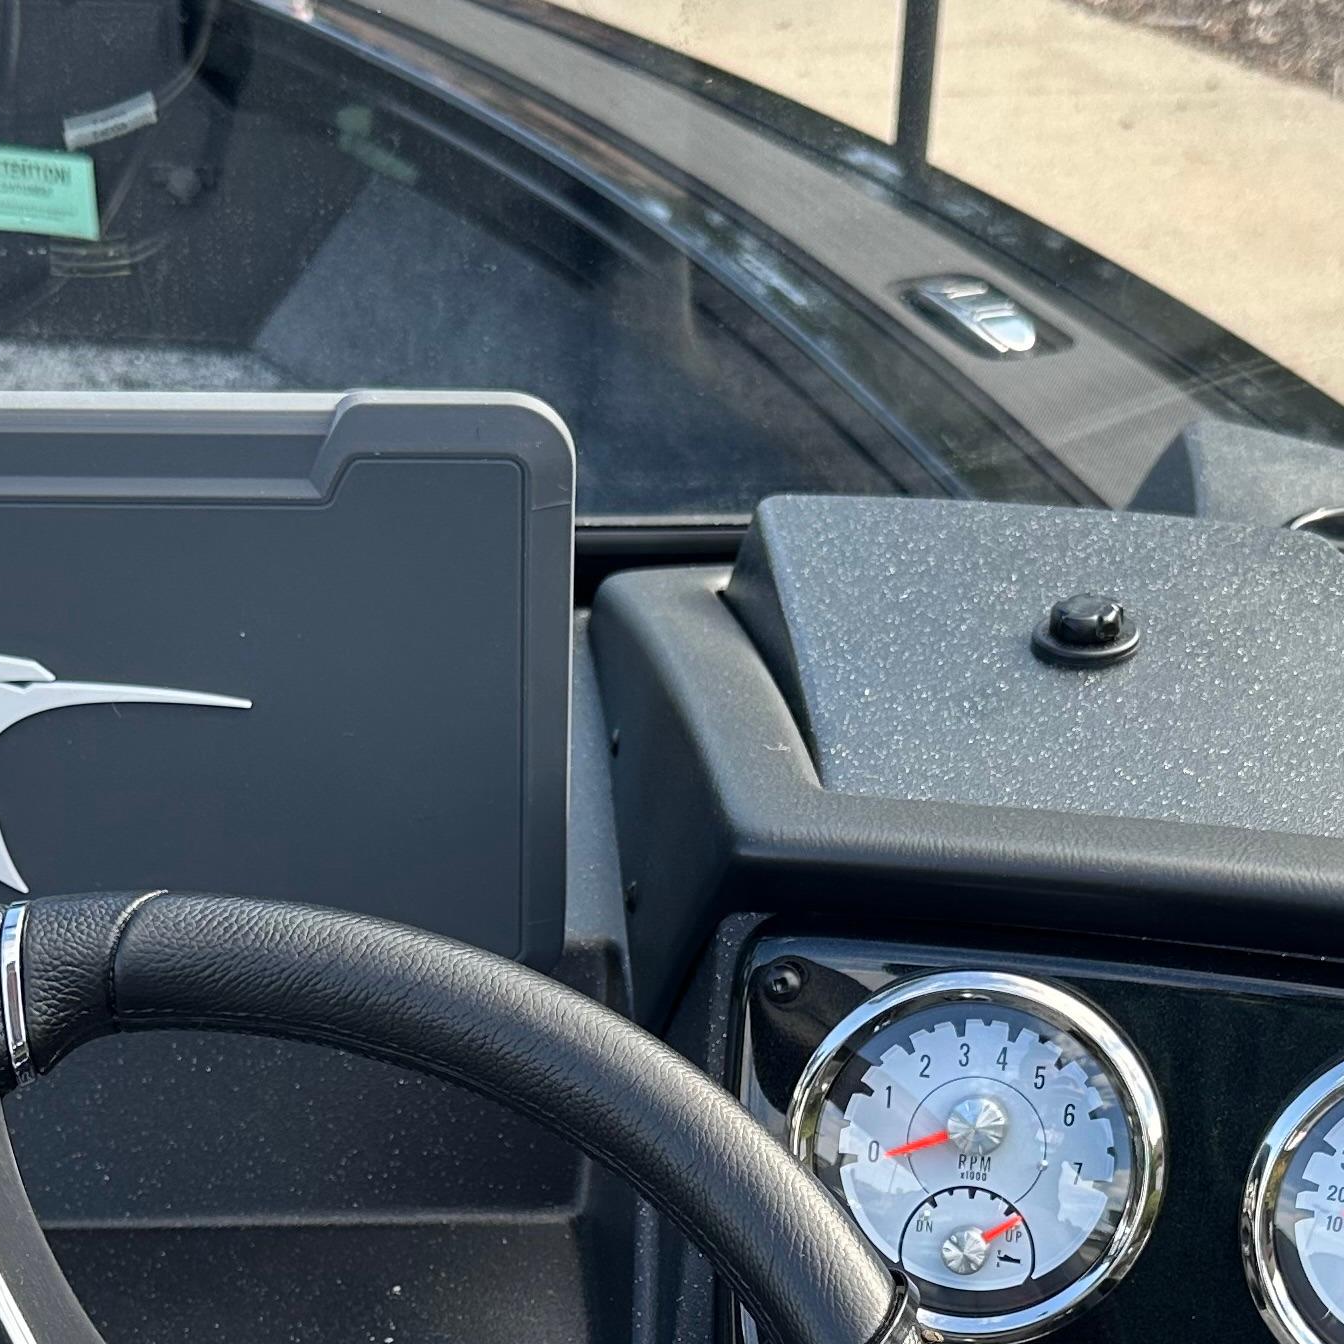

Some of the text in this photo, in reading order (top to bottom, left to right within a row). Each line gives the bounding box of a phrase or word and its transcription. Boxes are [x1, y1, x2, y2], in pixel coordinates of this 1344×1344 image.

[959, 1044, 970, 1066] 3
[997, 1047, 1008, 1071] 4
[920, 1055, 931, 1078] 2
[1034, 1066, 1045, 1090] 5
[885, 1086, 892, 1108] 1
[1064, 1104, 1075, 1127] 6
[868, 1140, 879, 1163] 0
[958, 1154, 991, 1173] RPM
[1074, 1162, 1083, 1185] 7
[916, 1219, 933, 1233] DN
[1326, 1216, 1343, 1232] 10
[1006, 1228, 1023, 1243] UP
